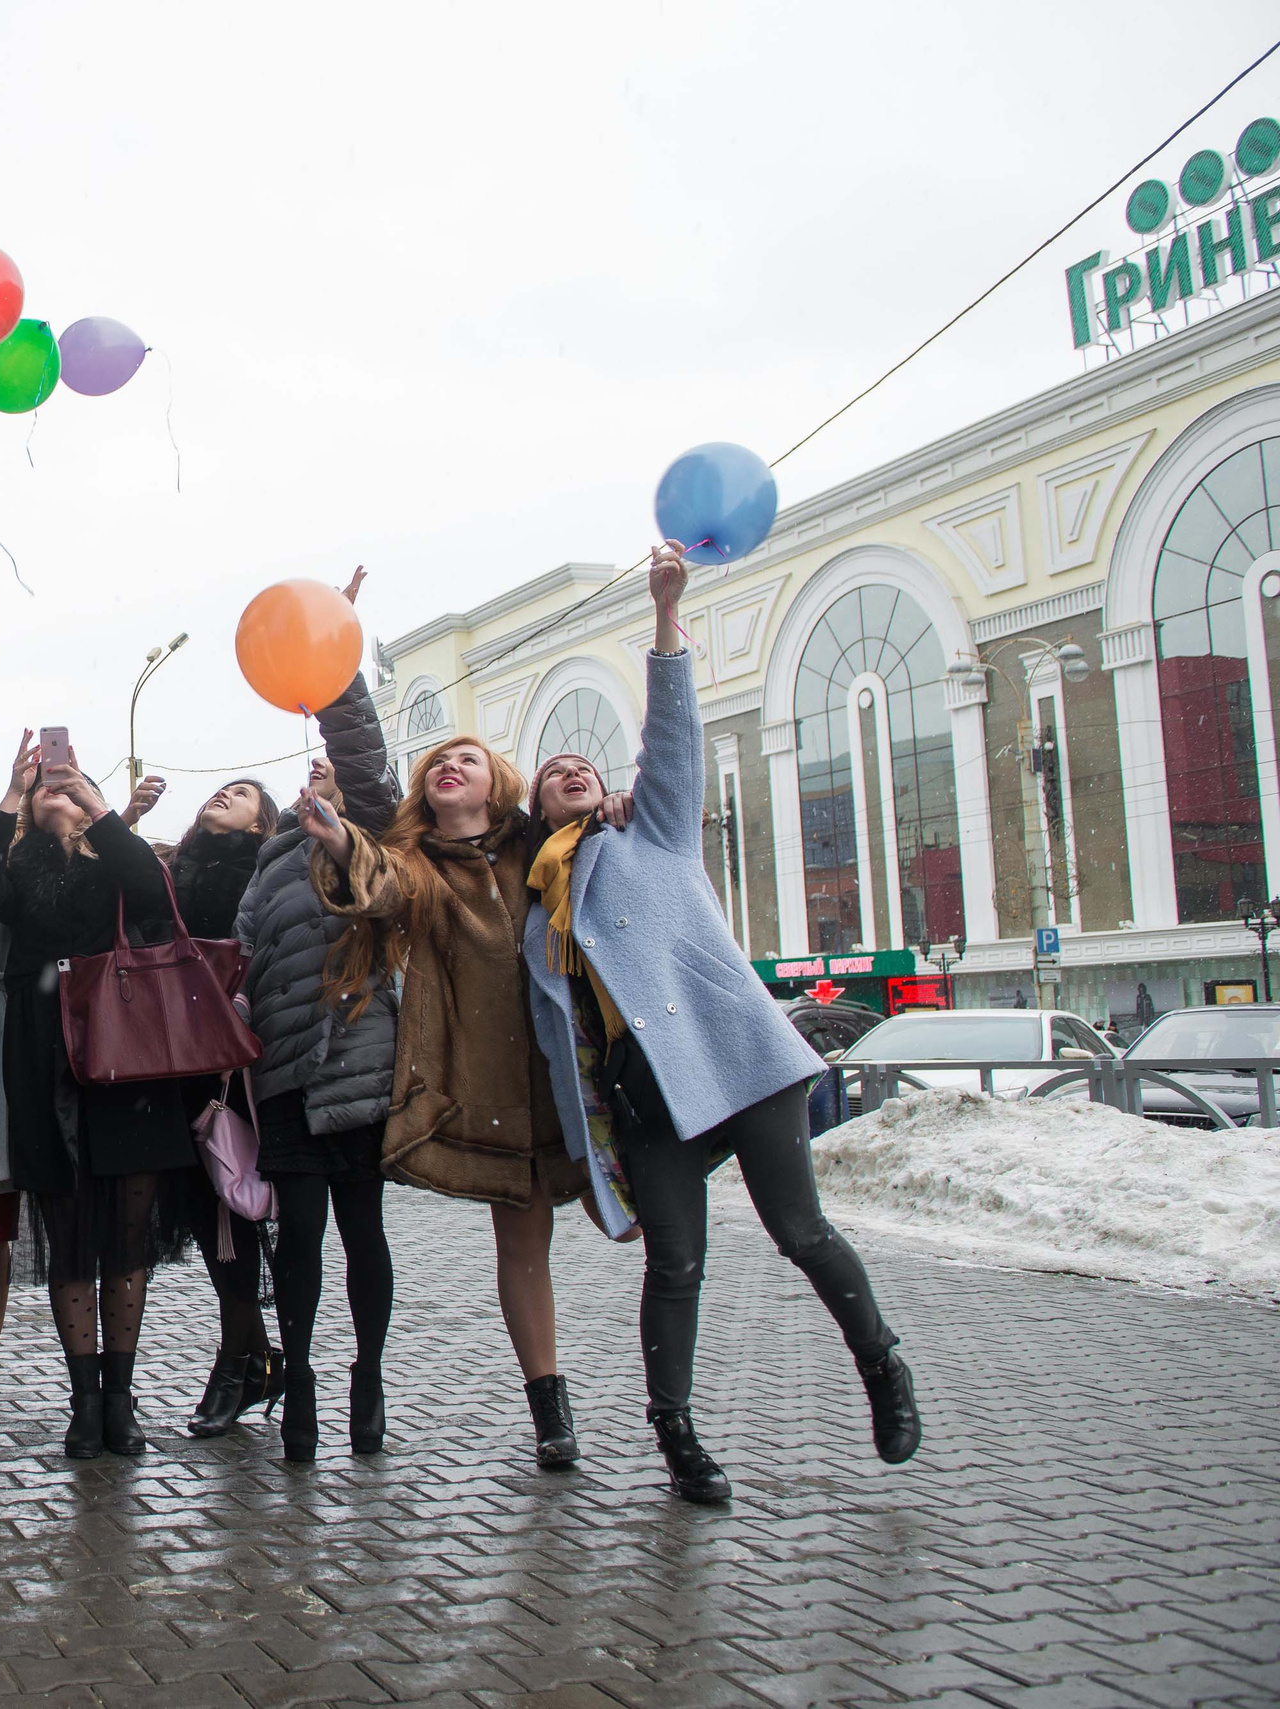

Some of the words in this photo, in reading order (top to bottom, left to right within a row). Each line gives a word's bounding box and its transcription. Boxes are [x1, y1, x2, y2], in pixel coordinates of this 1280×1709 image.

[1042, 930, 1056, 952] P
[775, 957, 825, 978] СЕВЕРНЫЙ
[829, 956, 875, 975] ПАРКИНГ
